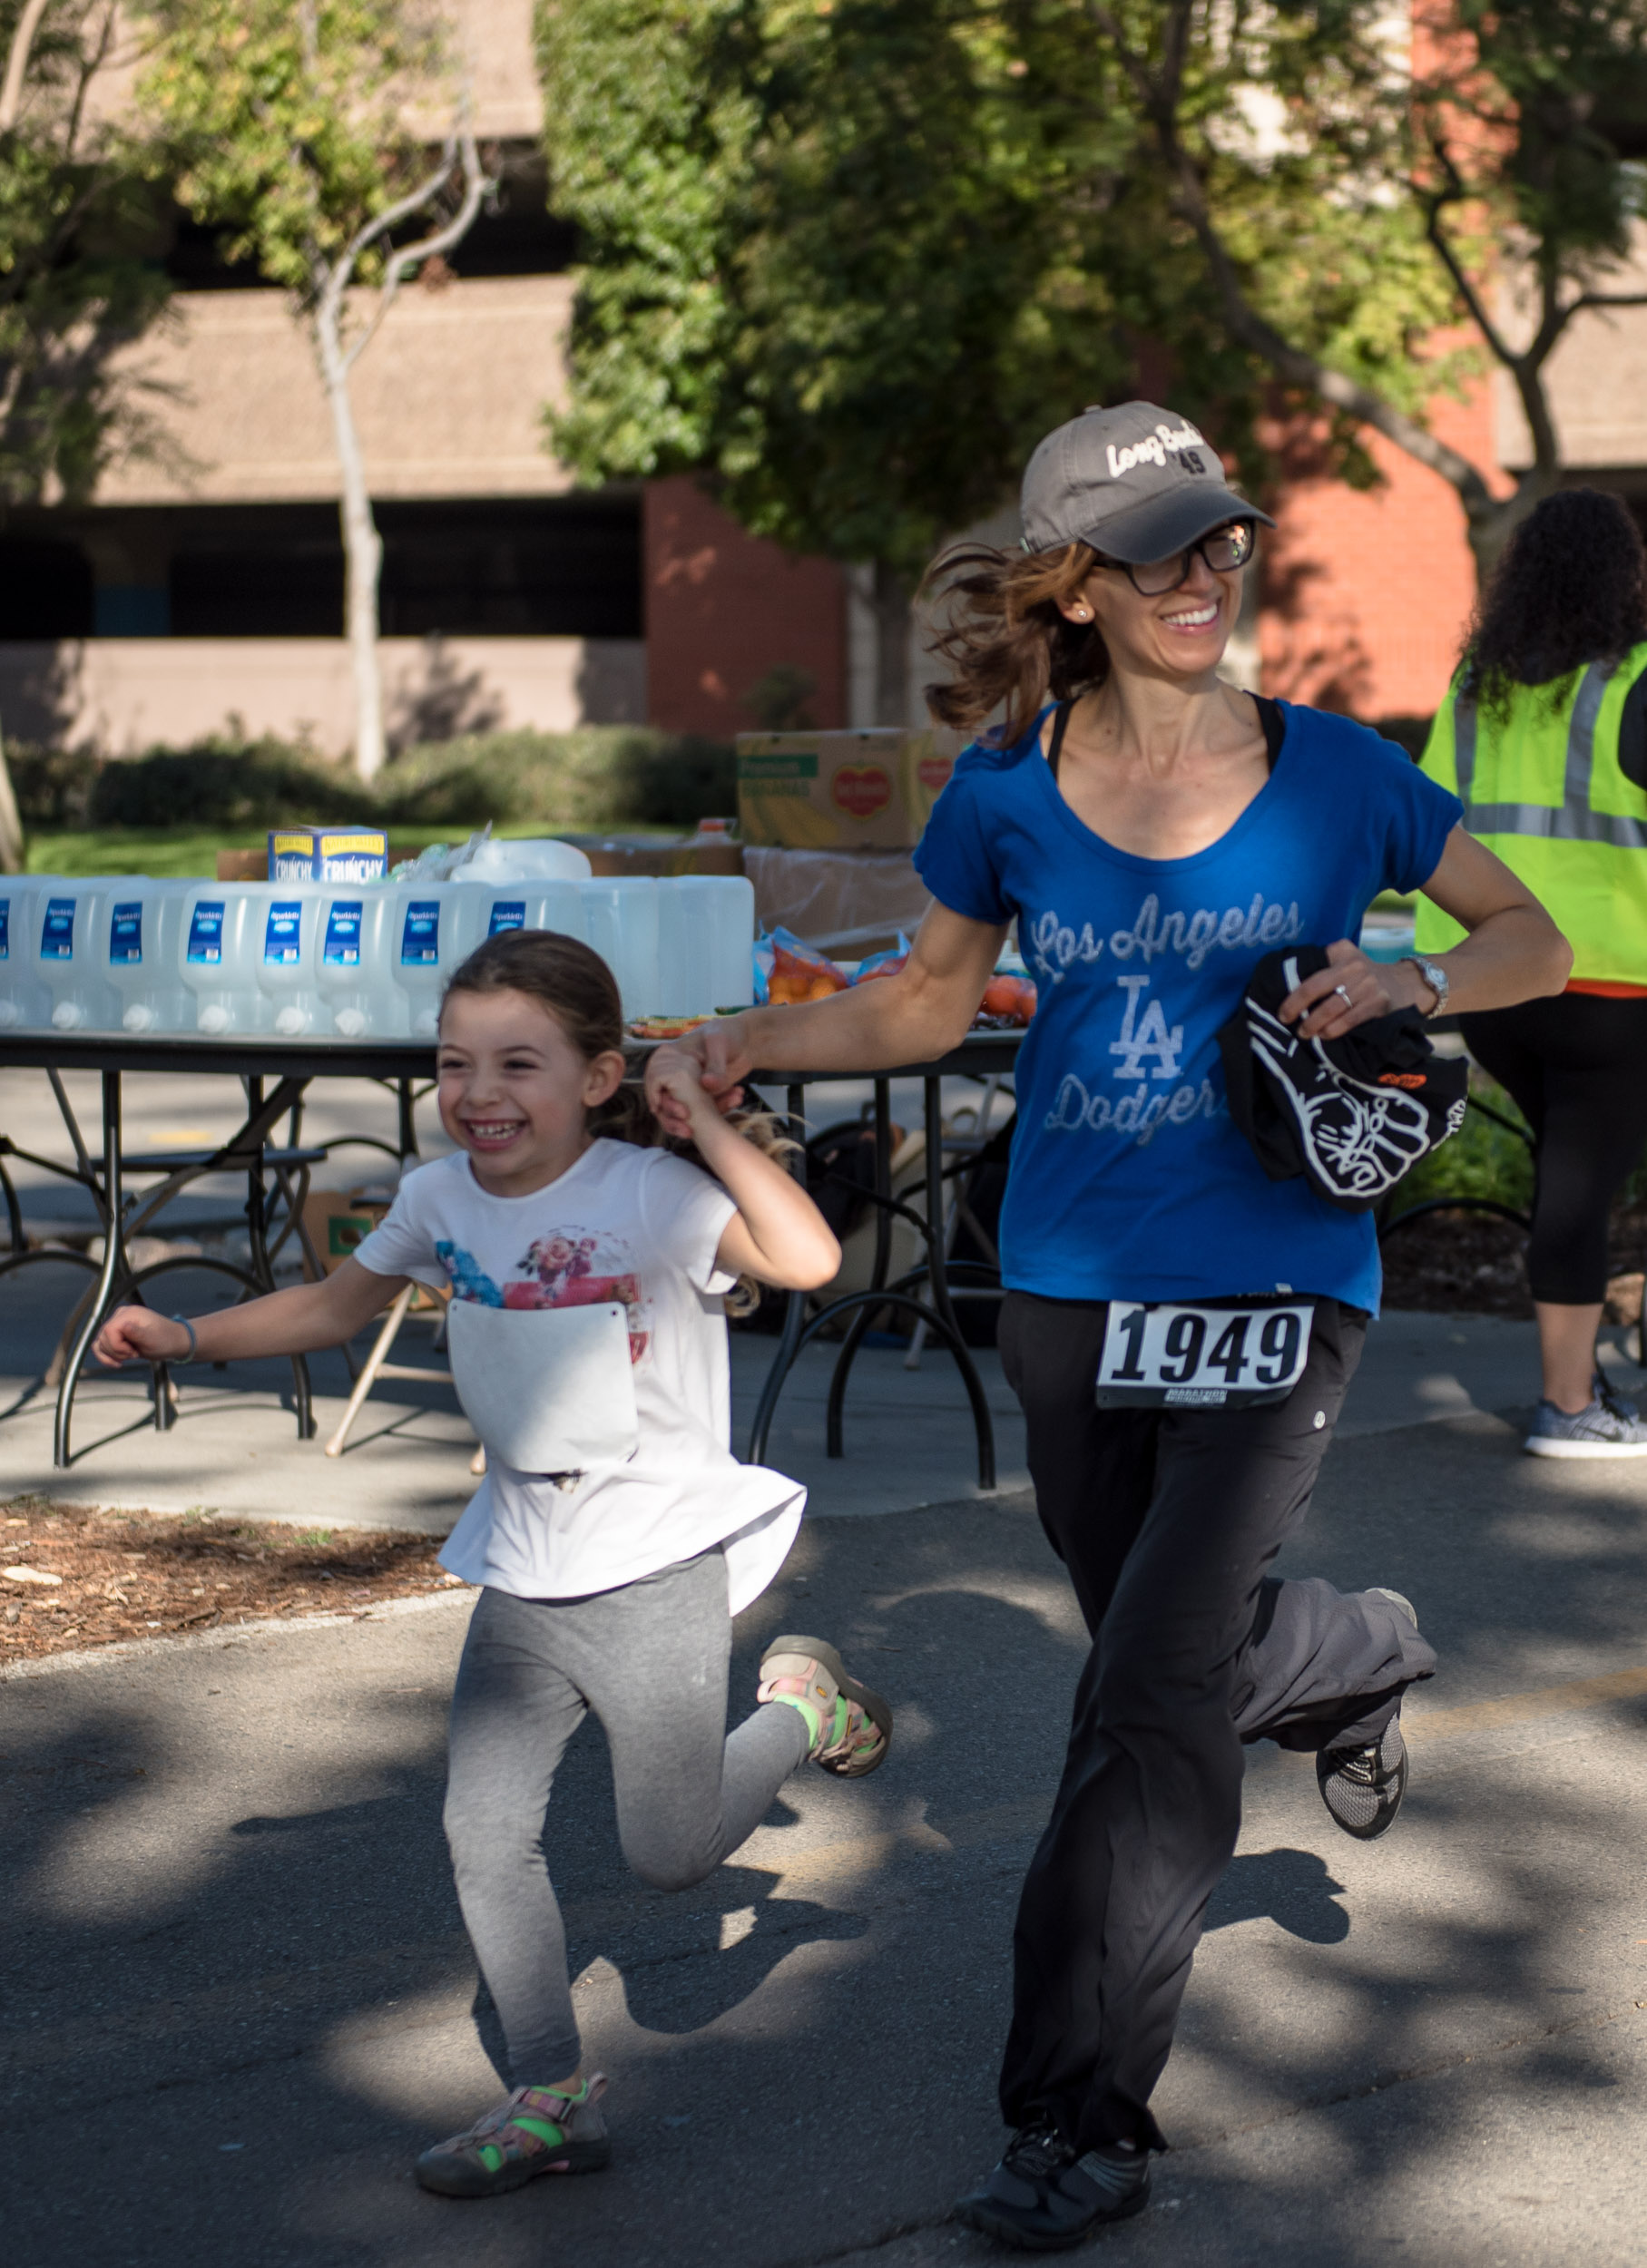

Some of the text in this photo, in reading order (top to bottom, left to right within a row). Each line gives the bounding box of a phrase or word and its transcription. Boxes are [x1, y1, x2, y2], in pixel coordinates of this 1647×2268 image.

[1106, 435, 1167, 478] Long
[1031, 893, 1305, 984] Los Angeles
[1109, 974, 1184, 1080] LA
[1044, 1072, 1230, 1146] Dodger
[1111, 1310, 1301, 1384] 1949
